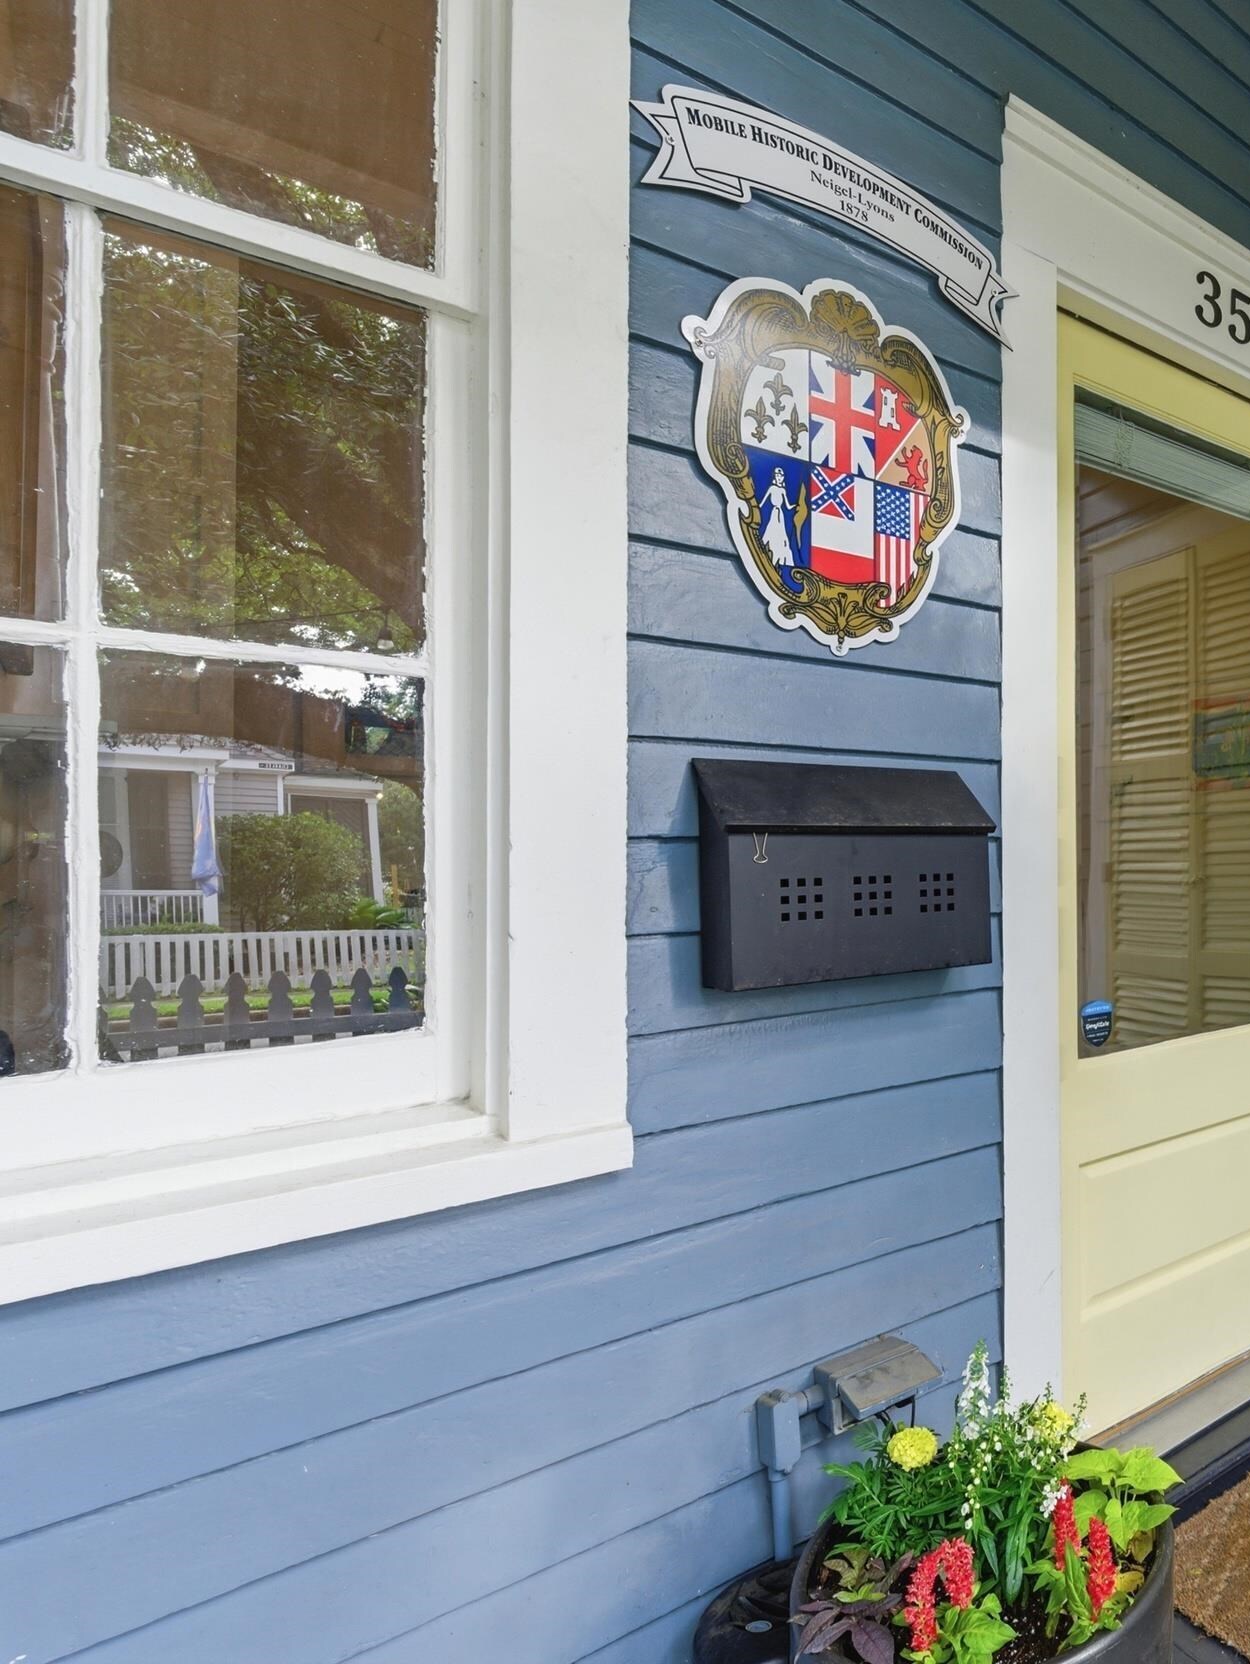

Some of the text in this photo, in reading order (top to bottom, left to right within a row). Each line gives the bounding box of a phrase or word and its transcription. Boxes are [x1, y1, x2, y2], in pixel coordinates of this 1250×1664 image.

[686, 107, 983, 271] MOBILE HISTORIC DEVELOPMENT COMMISSION
[810, 169, 896, 223] Neigel-Lyons
[840, 200, 869, 222] 1878
